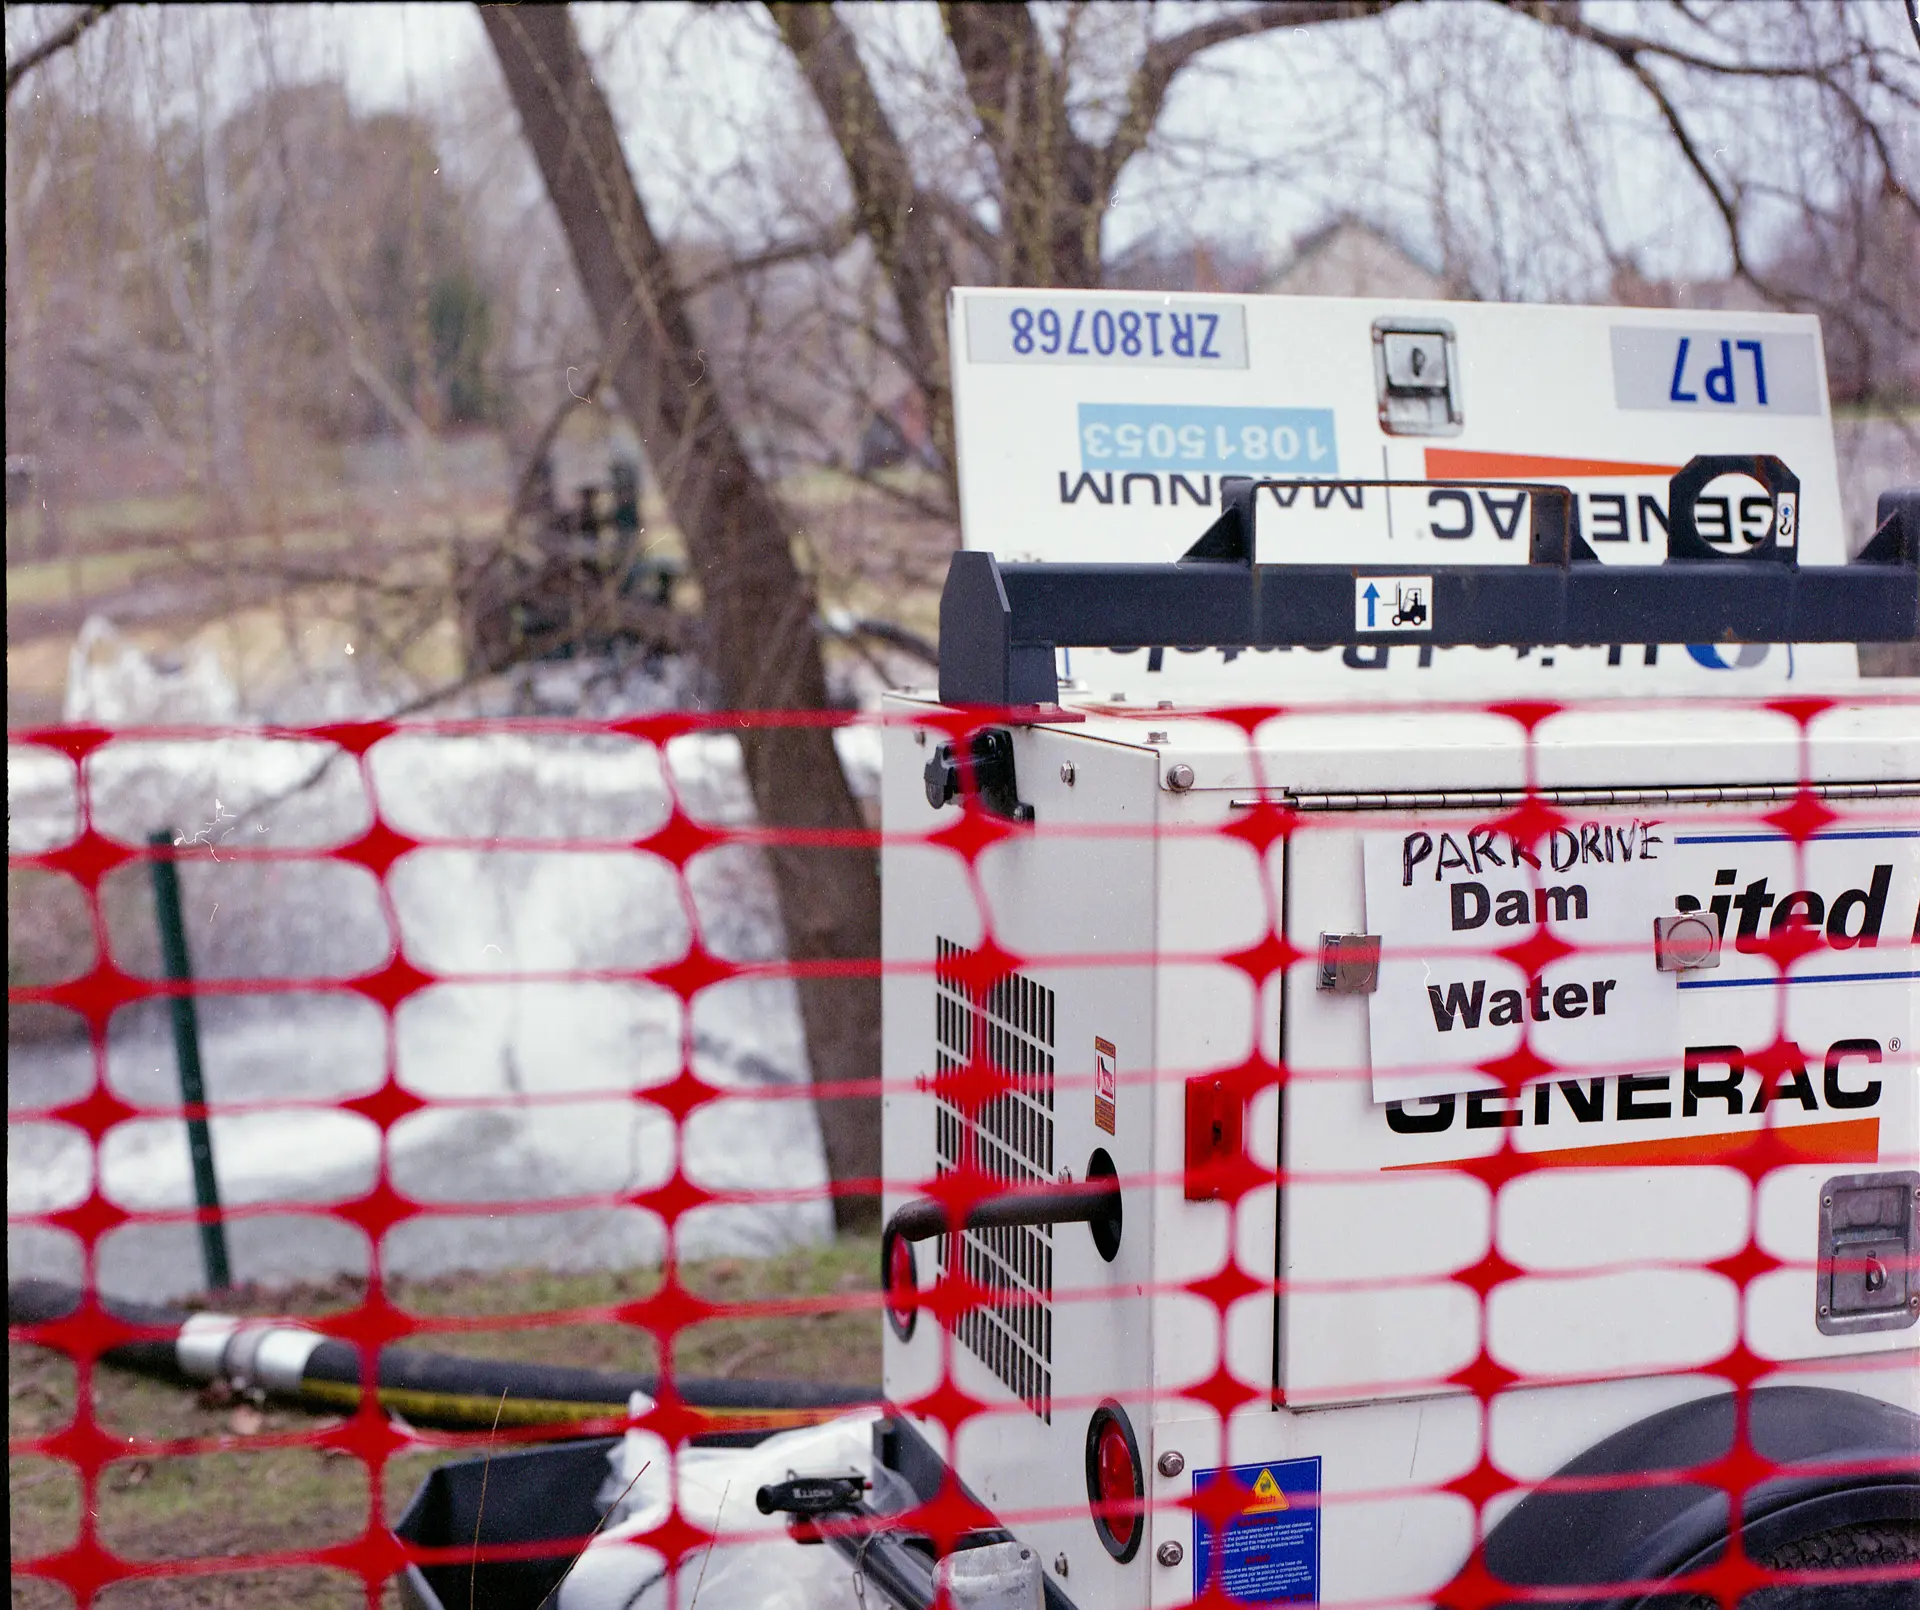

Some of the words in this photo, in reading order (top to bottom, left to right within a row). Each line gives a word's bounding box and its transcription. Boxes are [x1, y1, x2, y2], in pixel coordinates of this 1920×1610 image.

[1011, 307, 1221, 358] ZR180768
[1669, 337, 1768, 405] LP7
[1084, 423, 1329, 461] 10815053
[1059, 471, 1365, 509] MANUM
[1429, 490, 1775, 543] GENEAC
[1402, 822, 1542, 887] PARK
[1550, 818, 1665, 873] DRIVE
[1450, 881, 1589, 931] Dam
[1675, 864, 1894, 954] ited
[1427, 975, 1617, 1032] Water
